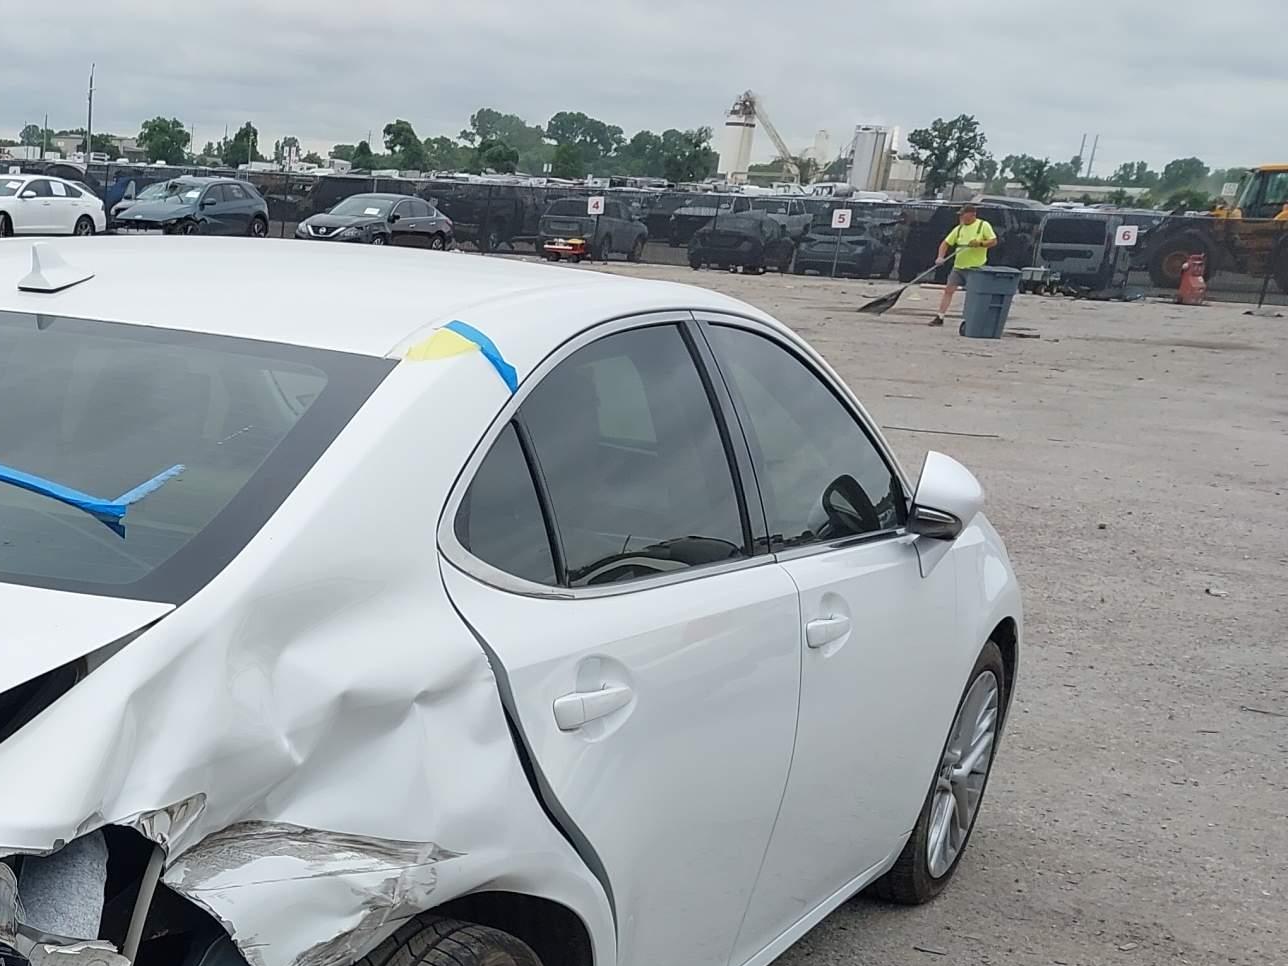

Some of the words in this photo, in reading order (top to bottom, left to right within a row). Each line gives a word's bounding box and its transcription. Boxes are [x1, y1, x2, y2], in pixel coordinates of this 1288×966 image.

[592, 201, 600, 210] 4
[838, 214, 846, 223] 5
[1122, 231, 1131, 240] 6
